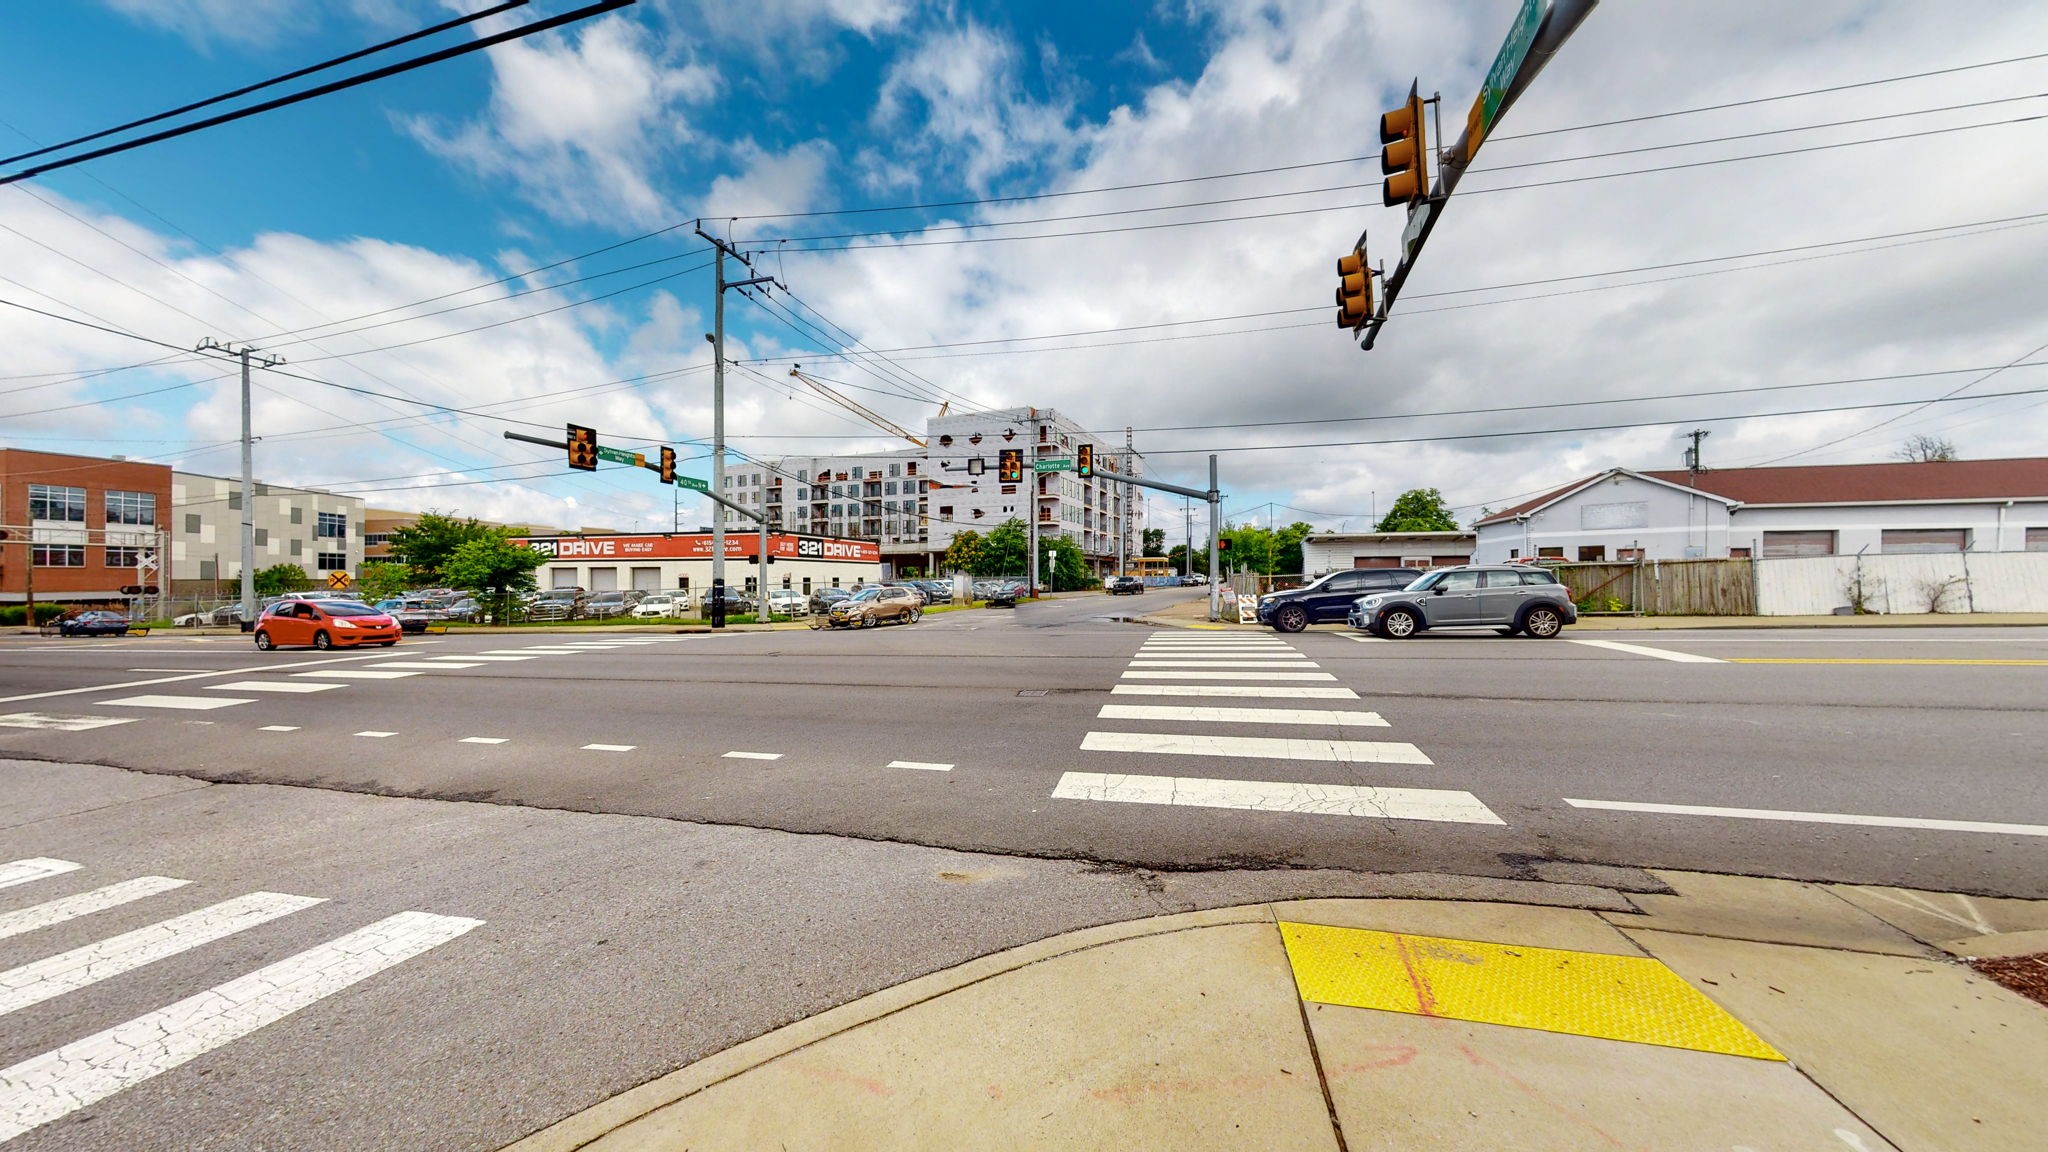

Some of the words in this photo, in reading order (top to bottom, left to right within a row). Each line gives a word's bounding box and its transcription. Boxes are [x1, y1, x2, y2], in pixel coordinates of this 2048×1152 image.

[559, 541, 615, 555] DRIVE
[798, 541, 822, 556] 321
[824, 542, 861, 558] DRIVE
